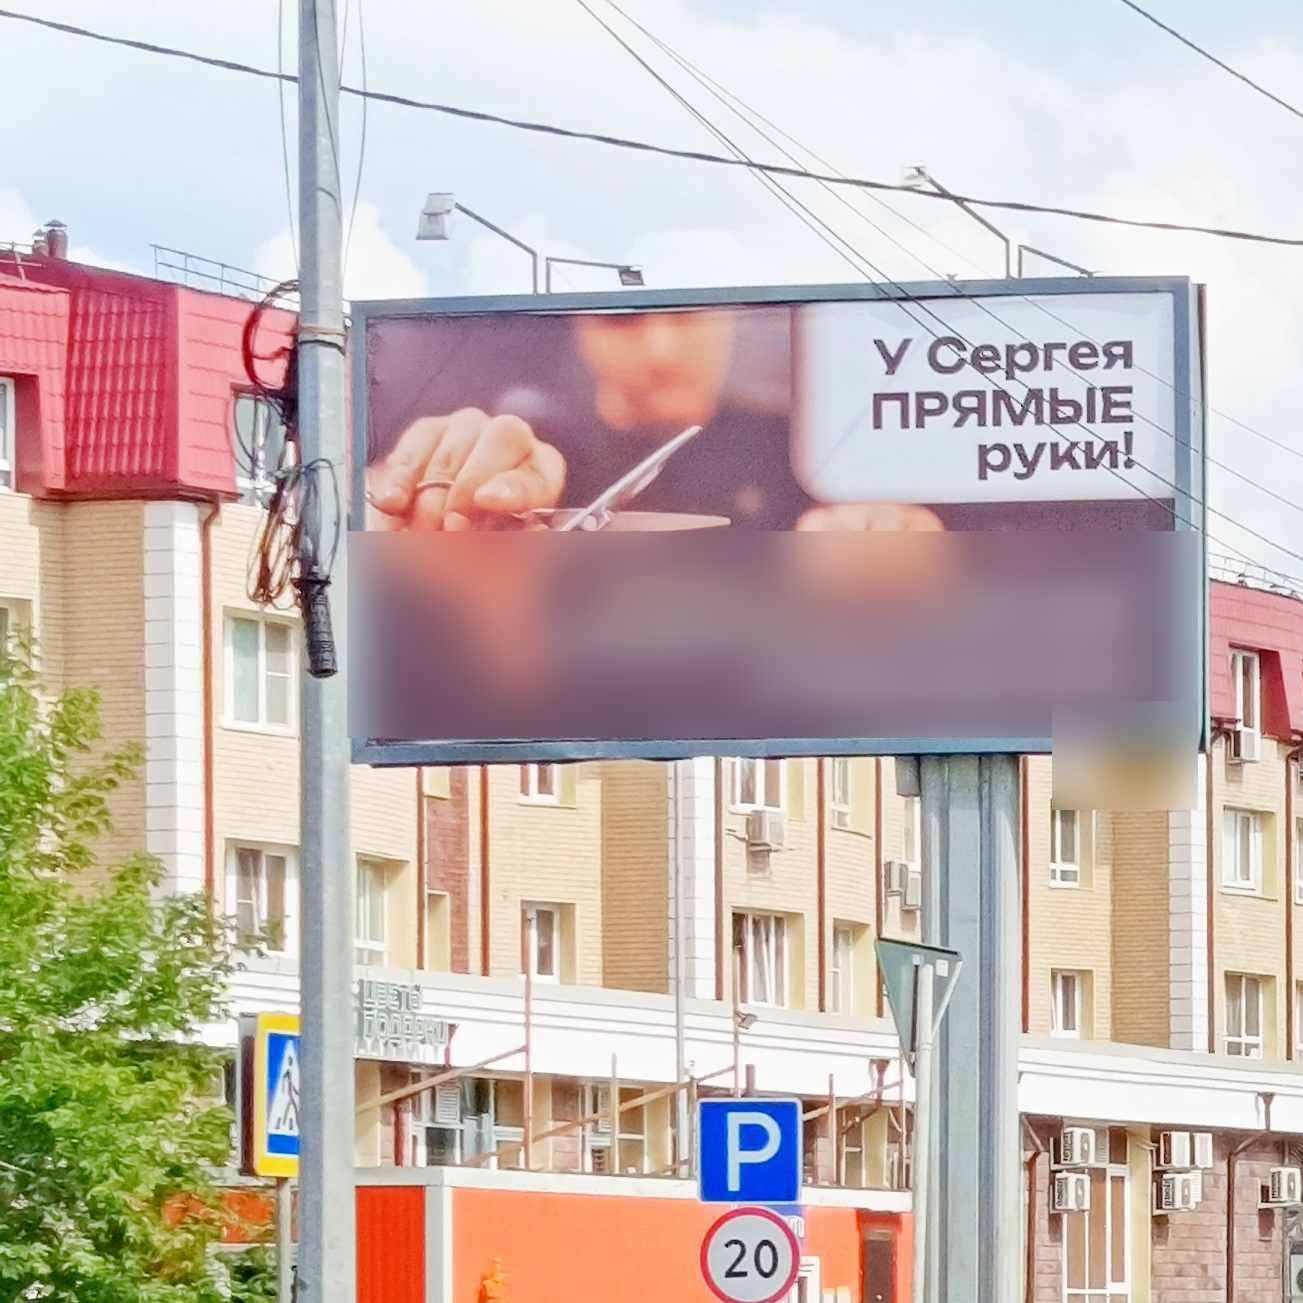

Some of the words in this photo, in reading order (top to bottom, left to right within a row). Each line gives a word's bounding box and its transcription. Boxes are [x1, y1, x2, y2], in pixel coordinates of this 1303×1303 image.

[873, 338, 913, 376] У
[927, 335, 1134, 381] Сергея
[871, 385, 1134, 430] ПРЯМЫЕ
[977, 430, 1136, 481] руки!
[727, 1112, 781, 1192] P
[724, 1239, 778, 1278] 20
